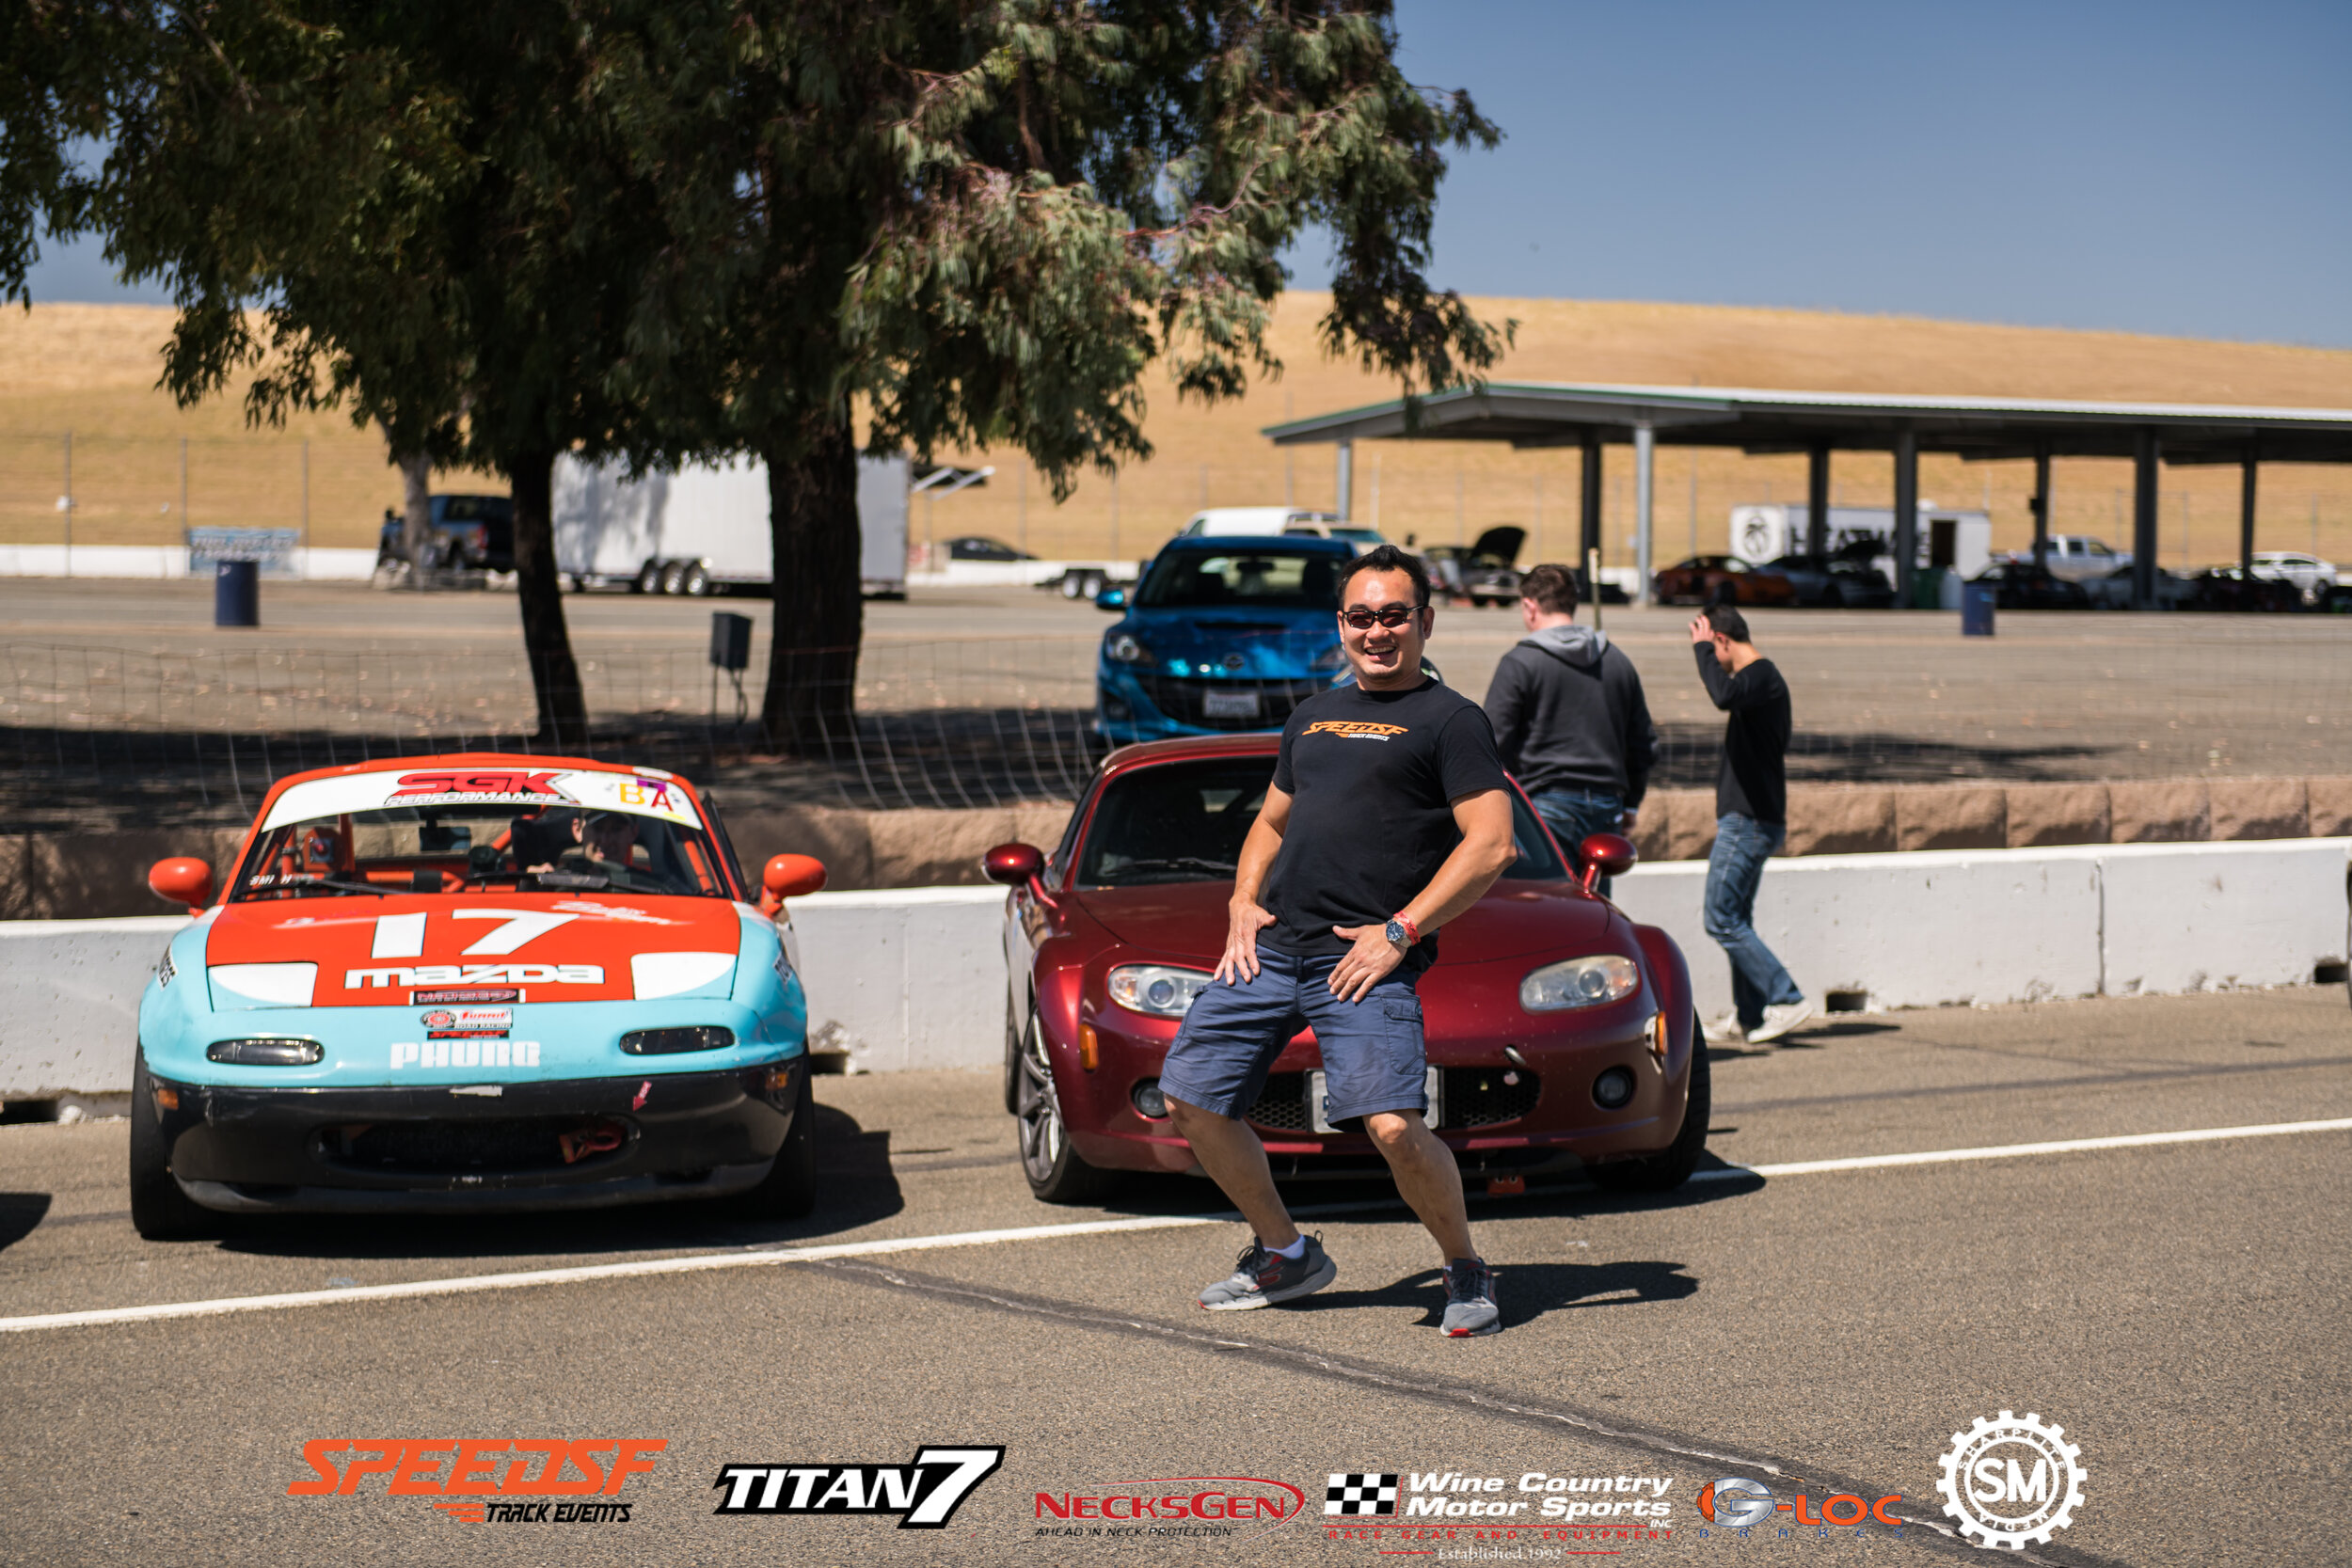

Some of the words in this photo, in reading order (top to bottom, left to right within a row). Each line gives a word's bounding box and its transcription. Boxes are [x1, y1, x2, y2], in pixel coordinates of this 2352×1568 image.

[1302, 721, 1409, 736] SPEEDSF
[391, 770, 569, 798] SGK
[619, 782, 645, 805] B
[650, 788, 674, 812] A
[384, 791, 564, 807] PERFORMANCE
[370, 908, 580, 959] 17
[389, 1040, 541, 1069] PHUNG
